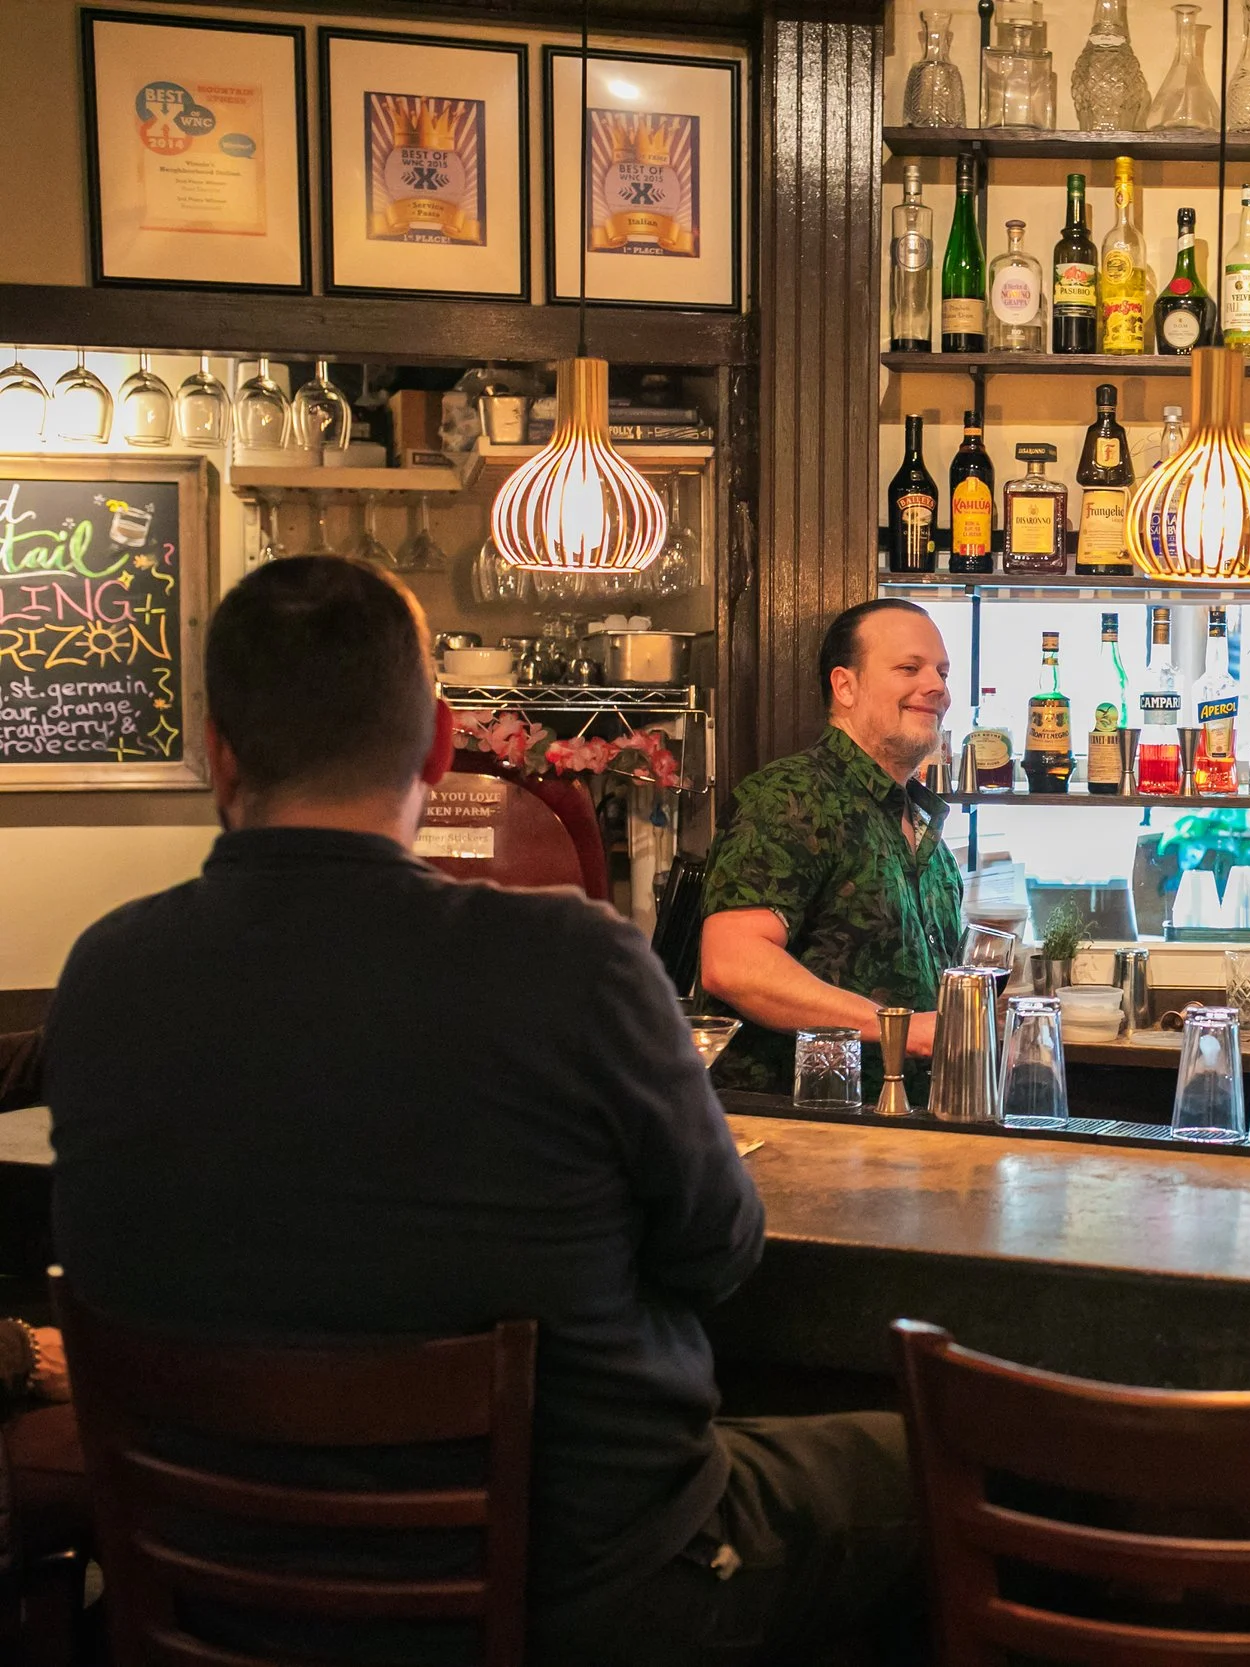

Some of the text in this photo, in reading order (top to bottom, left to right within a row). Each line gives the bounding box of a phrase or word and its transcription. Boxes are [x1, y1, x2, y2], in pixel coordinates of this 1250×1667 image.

[145, 88, 184, 102] BEST
[180, 117, 213, 128] WNC
[149, 138, 185, 150] 2014
[401, 149, 448, 160] BEST OF
[402, 159, 448, 168] WNC 2015
[619, 164, 664, 175] BEST OF
[644, 175, 664, 183] 2015
[628, 218, 658, 227] Italian
[416, 235, 451, 244] PLACE!
[1060, 287, 1090, 296] PASUBIO
[900, 495, 934, 508] BAILEYS
[954, 498, 991, 514] KAHLÚA
[1016, 516, 1051, 525] DISARONNO
[48, 700, 141, 724] orange,
[1201, 702, 1237, 719] APEROL
[121, 716, 138, 734] &
[1030, 728, 1069, 738] MONTENEGRO
[440, 792, 501, 802] YOU LOVE
